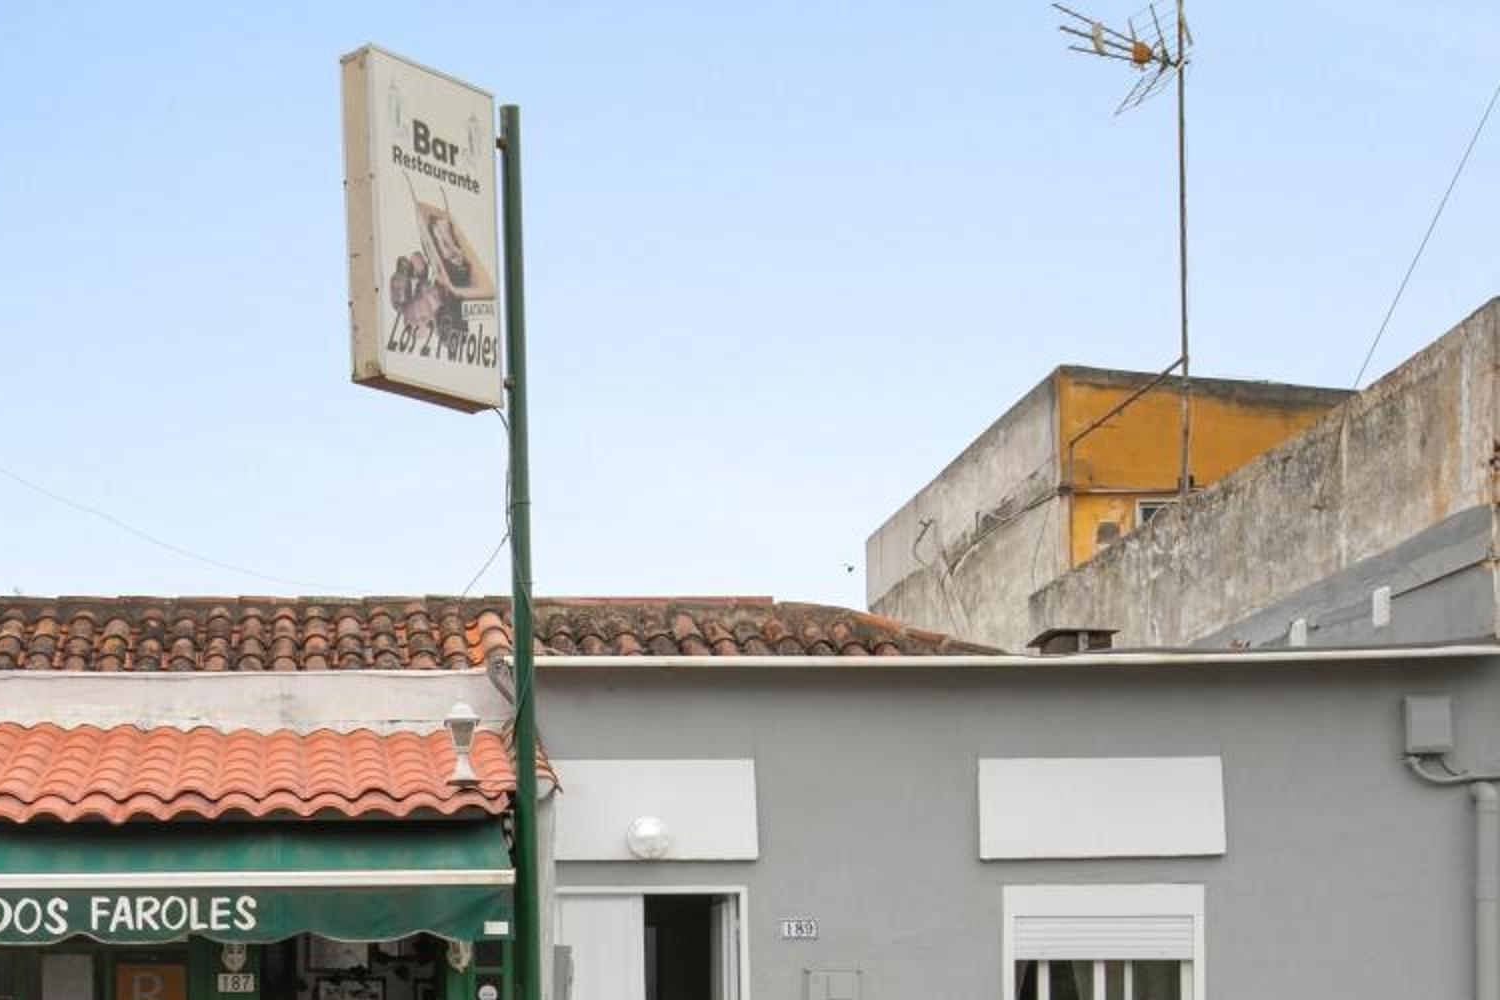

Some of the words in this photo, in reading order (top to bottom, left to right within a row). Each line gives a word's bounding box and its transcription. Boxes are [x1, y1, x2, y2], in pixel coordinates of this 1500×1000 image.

[412, 118, 459, 167] Bar
[392, 145, 480, 194] Restaurante
[387, 311, 419, 353] Los
[420, 319, 435, 357] 2
[436, 321, 497, 369] Faroles
[90, 895, 258, 933] FAROLES
[222, 975, 252, 991] 187
